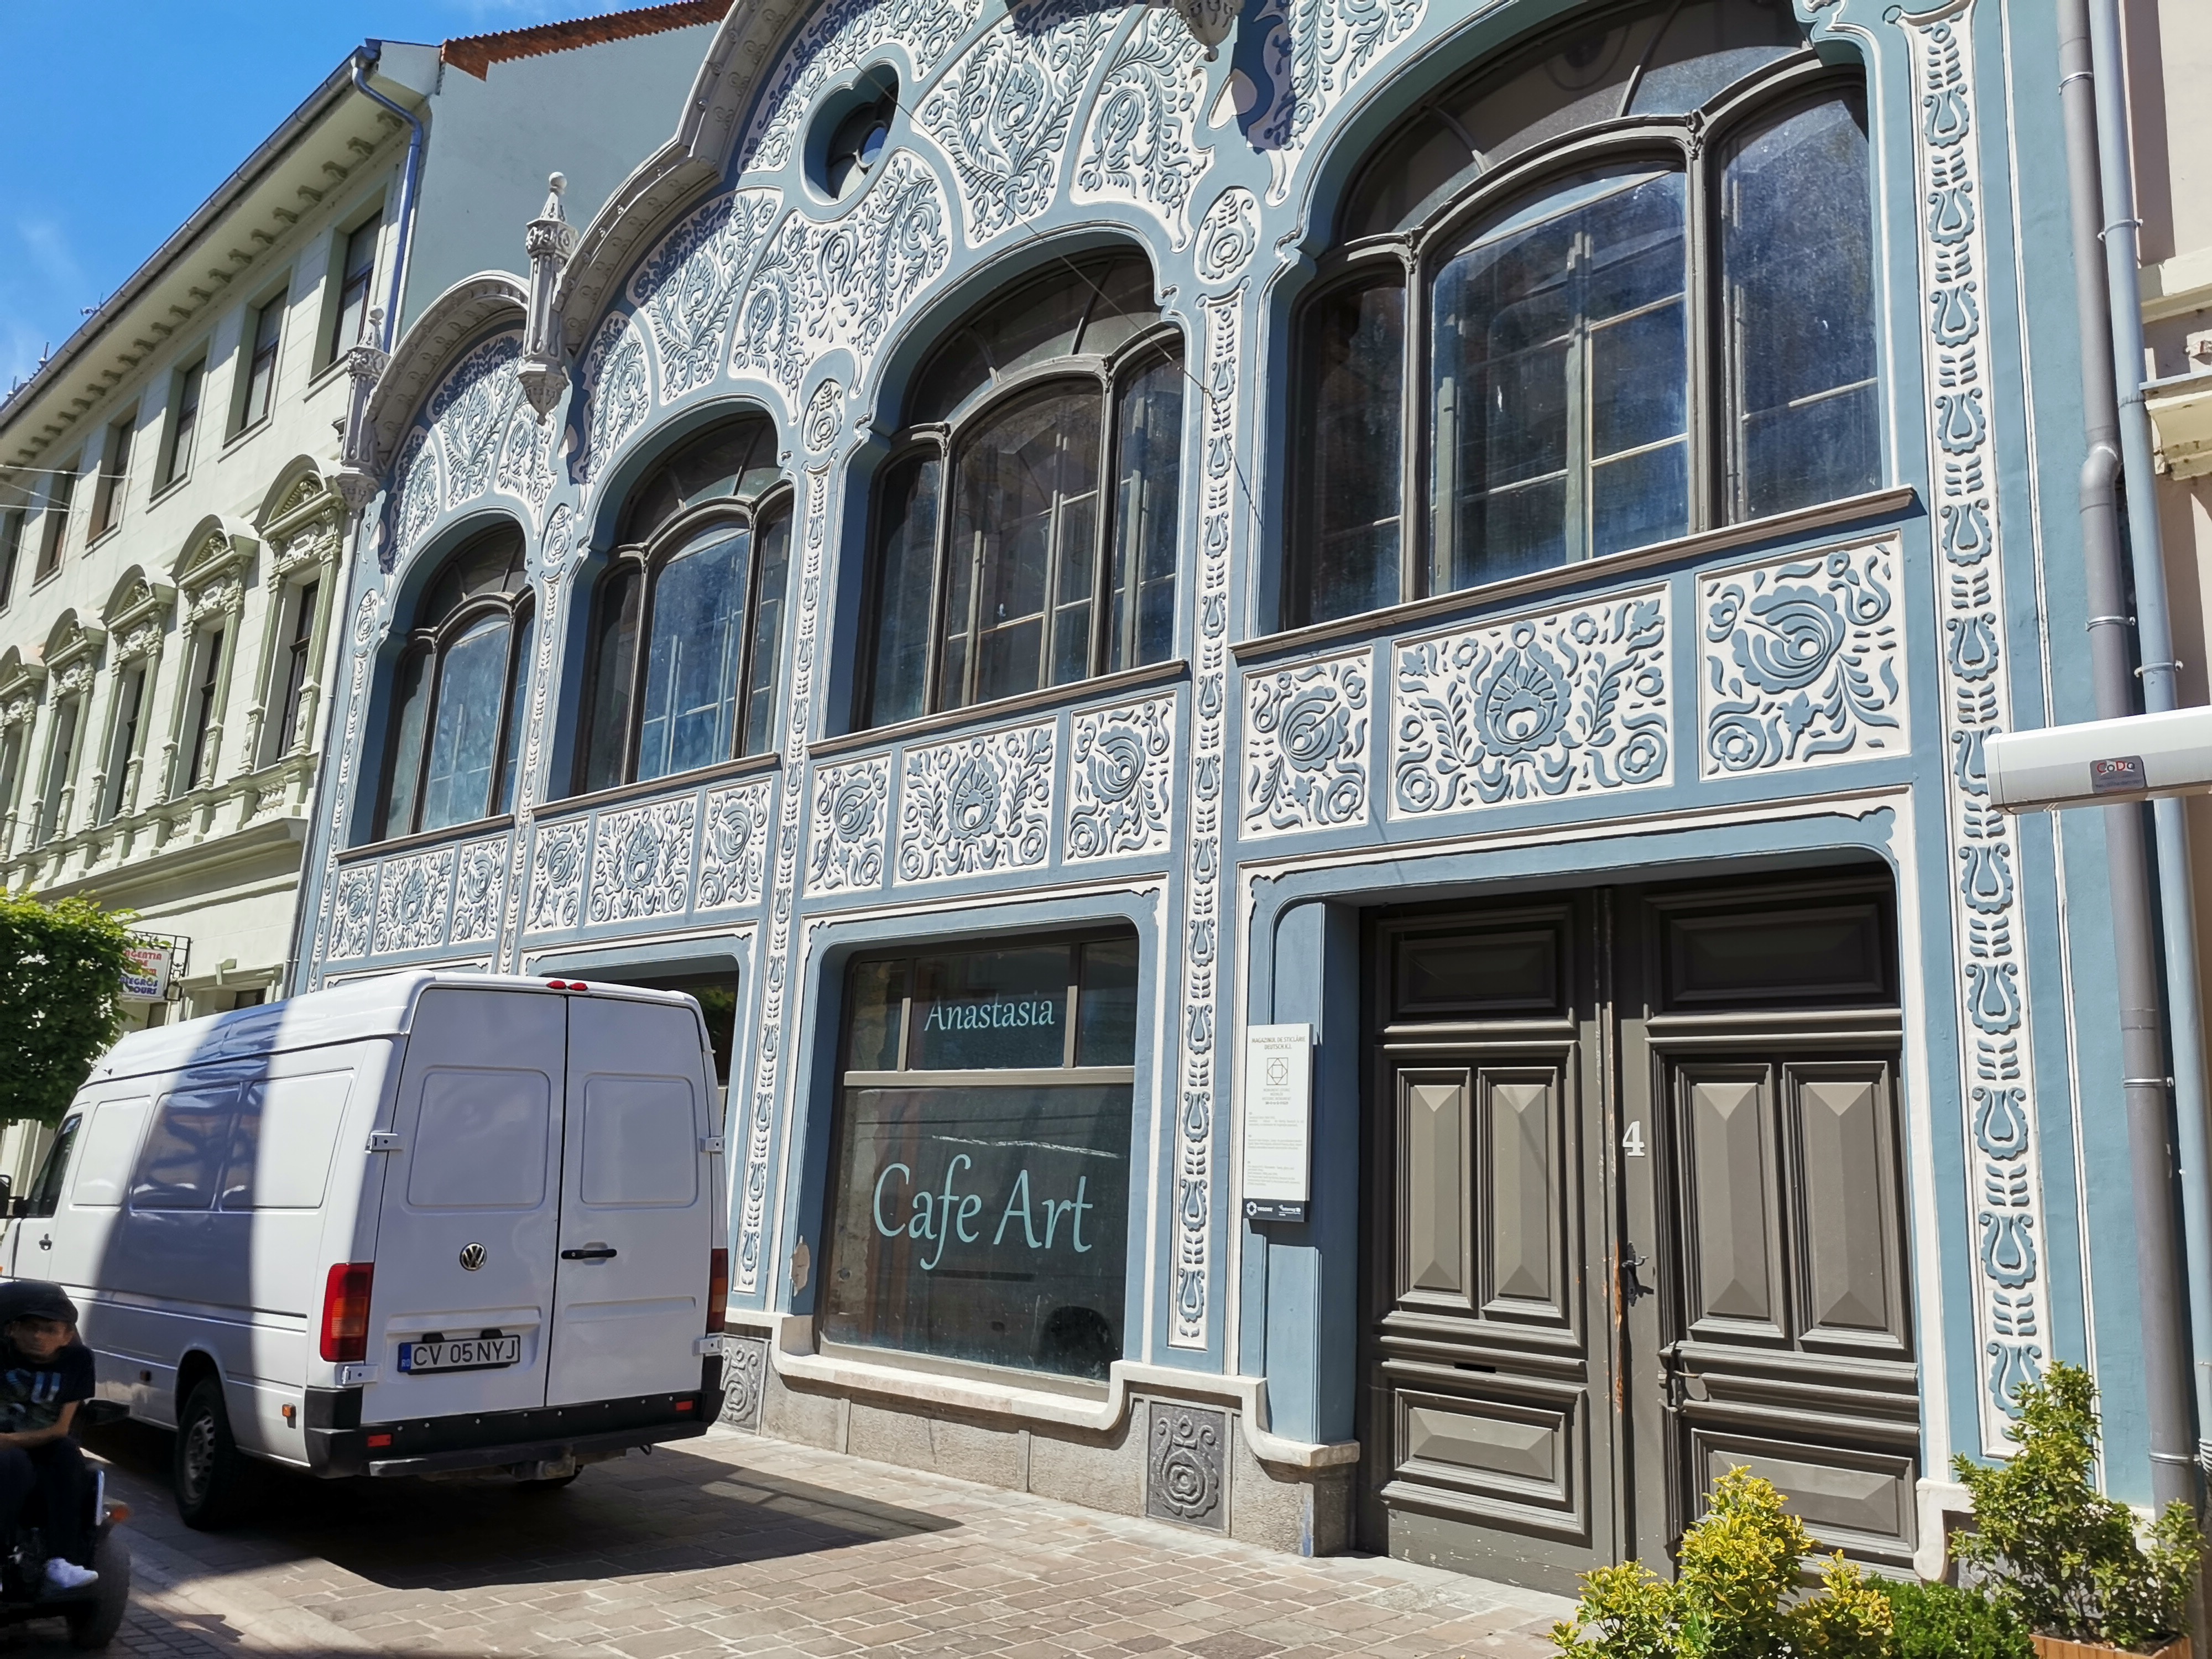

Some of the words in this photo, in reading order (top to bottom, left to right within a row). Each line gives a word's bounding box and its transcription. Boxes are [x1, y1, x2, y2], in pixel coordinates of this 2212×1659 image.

[132, 986, 158, 995] OURS
[924, 995, 1055, 1031] Anastasia
[1623, 1120, 1645, 1156] 4
[873, 1154, 983, 1270] Cafe
[993, 1169, 1093, 1253] Art
[401, 1358, 410, 1368] RO
[414, 1344, 442, 1366] CV
[450, 1343, 473, 1363] 05
[477, 1339, 515, 1362] NYJ
